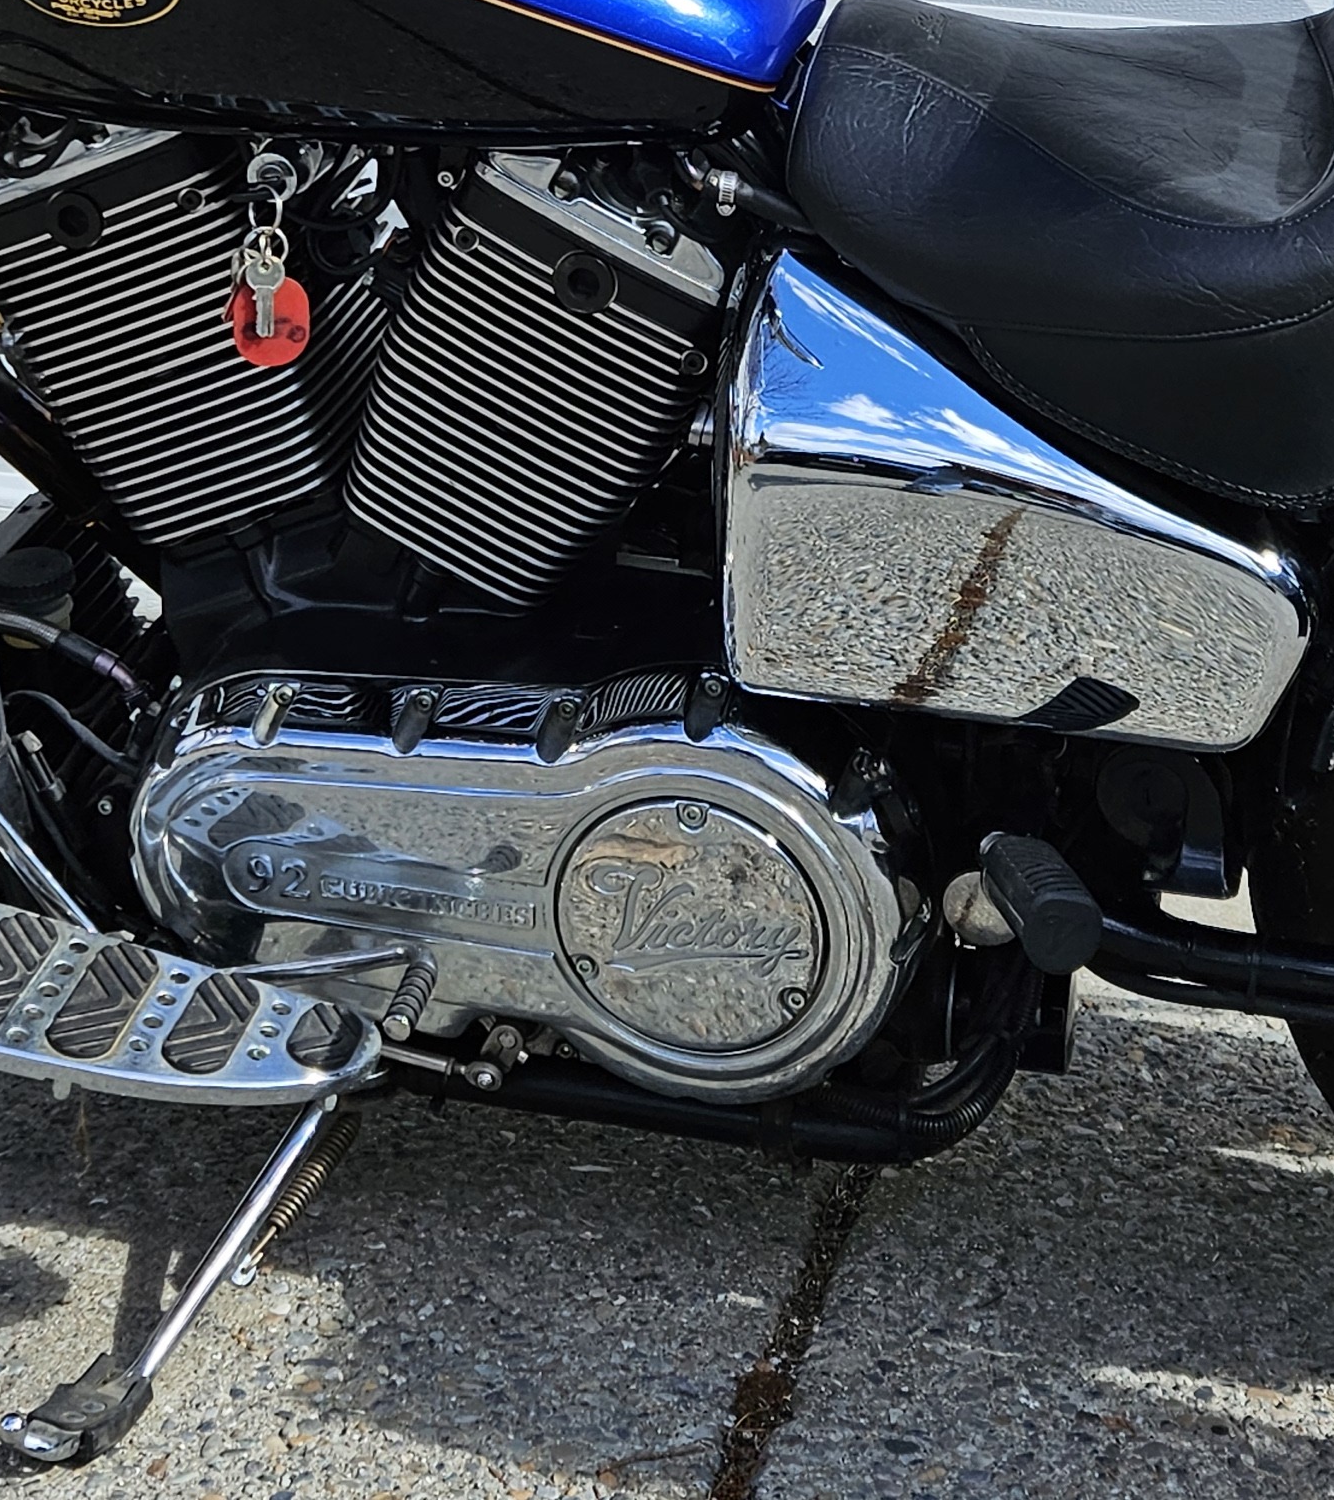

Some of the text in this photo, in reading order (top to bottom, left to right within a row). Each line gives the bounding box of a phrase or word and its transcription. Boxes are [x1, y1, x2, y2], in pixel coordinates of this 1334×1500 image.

[248, 852, 312, 898] 92
[421, 892, 534, 929] INCHES
[590, 863, 810, 978] Victory
